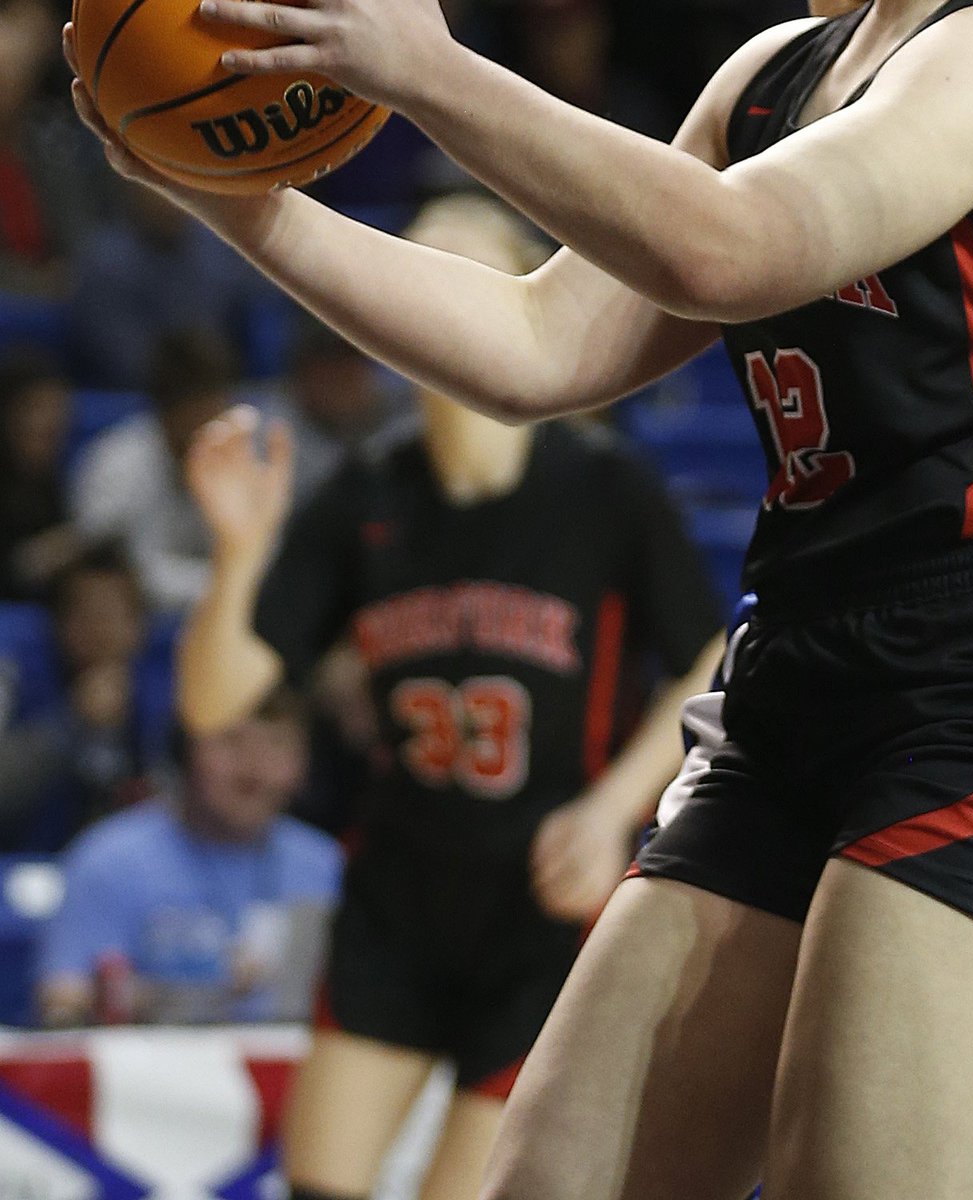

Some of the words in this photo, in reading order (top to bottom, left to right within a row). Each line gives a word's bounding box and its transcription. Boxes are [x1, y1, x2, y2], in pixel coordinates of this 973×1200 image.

[190, 80, 355, 158] Wils
[743, 346, 857, 513] 12
[389, 674, 533, 801] 33
